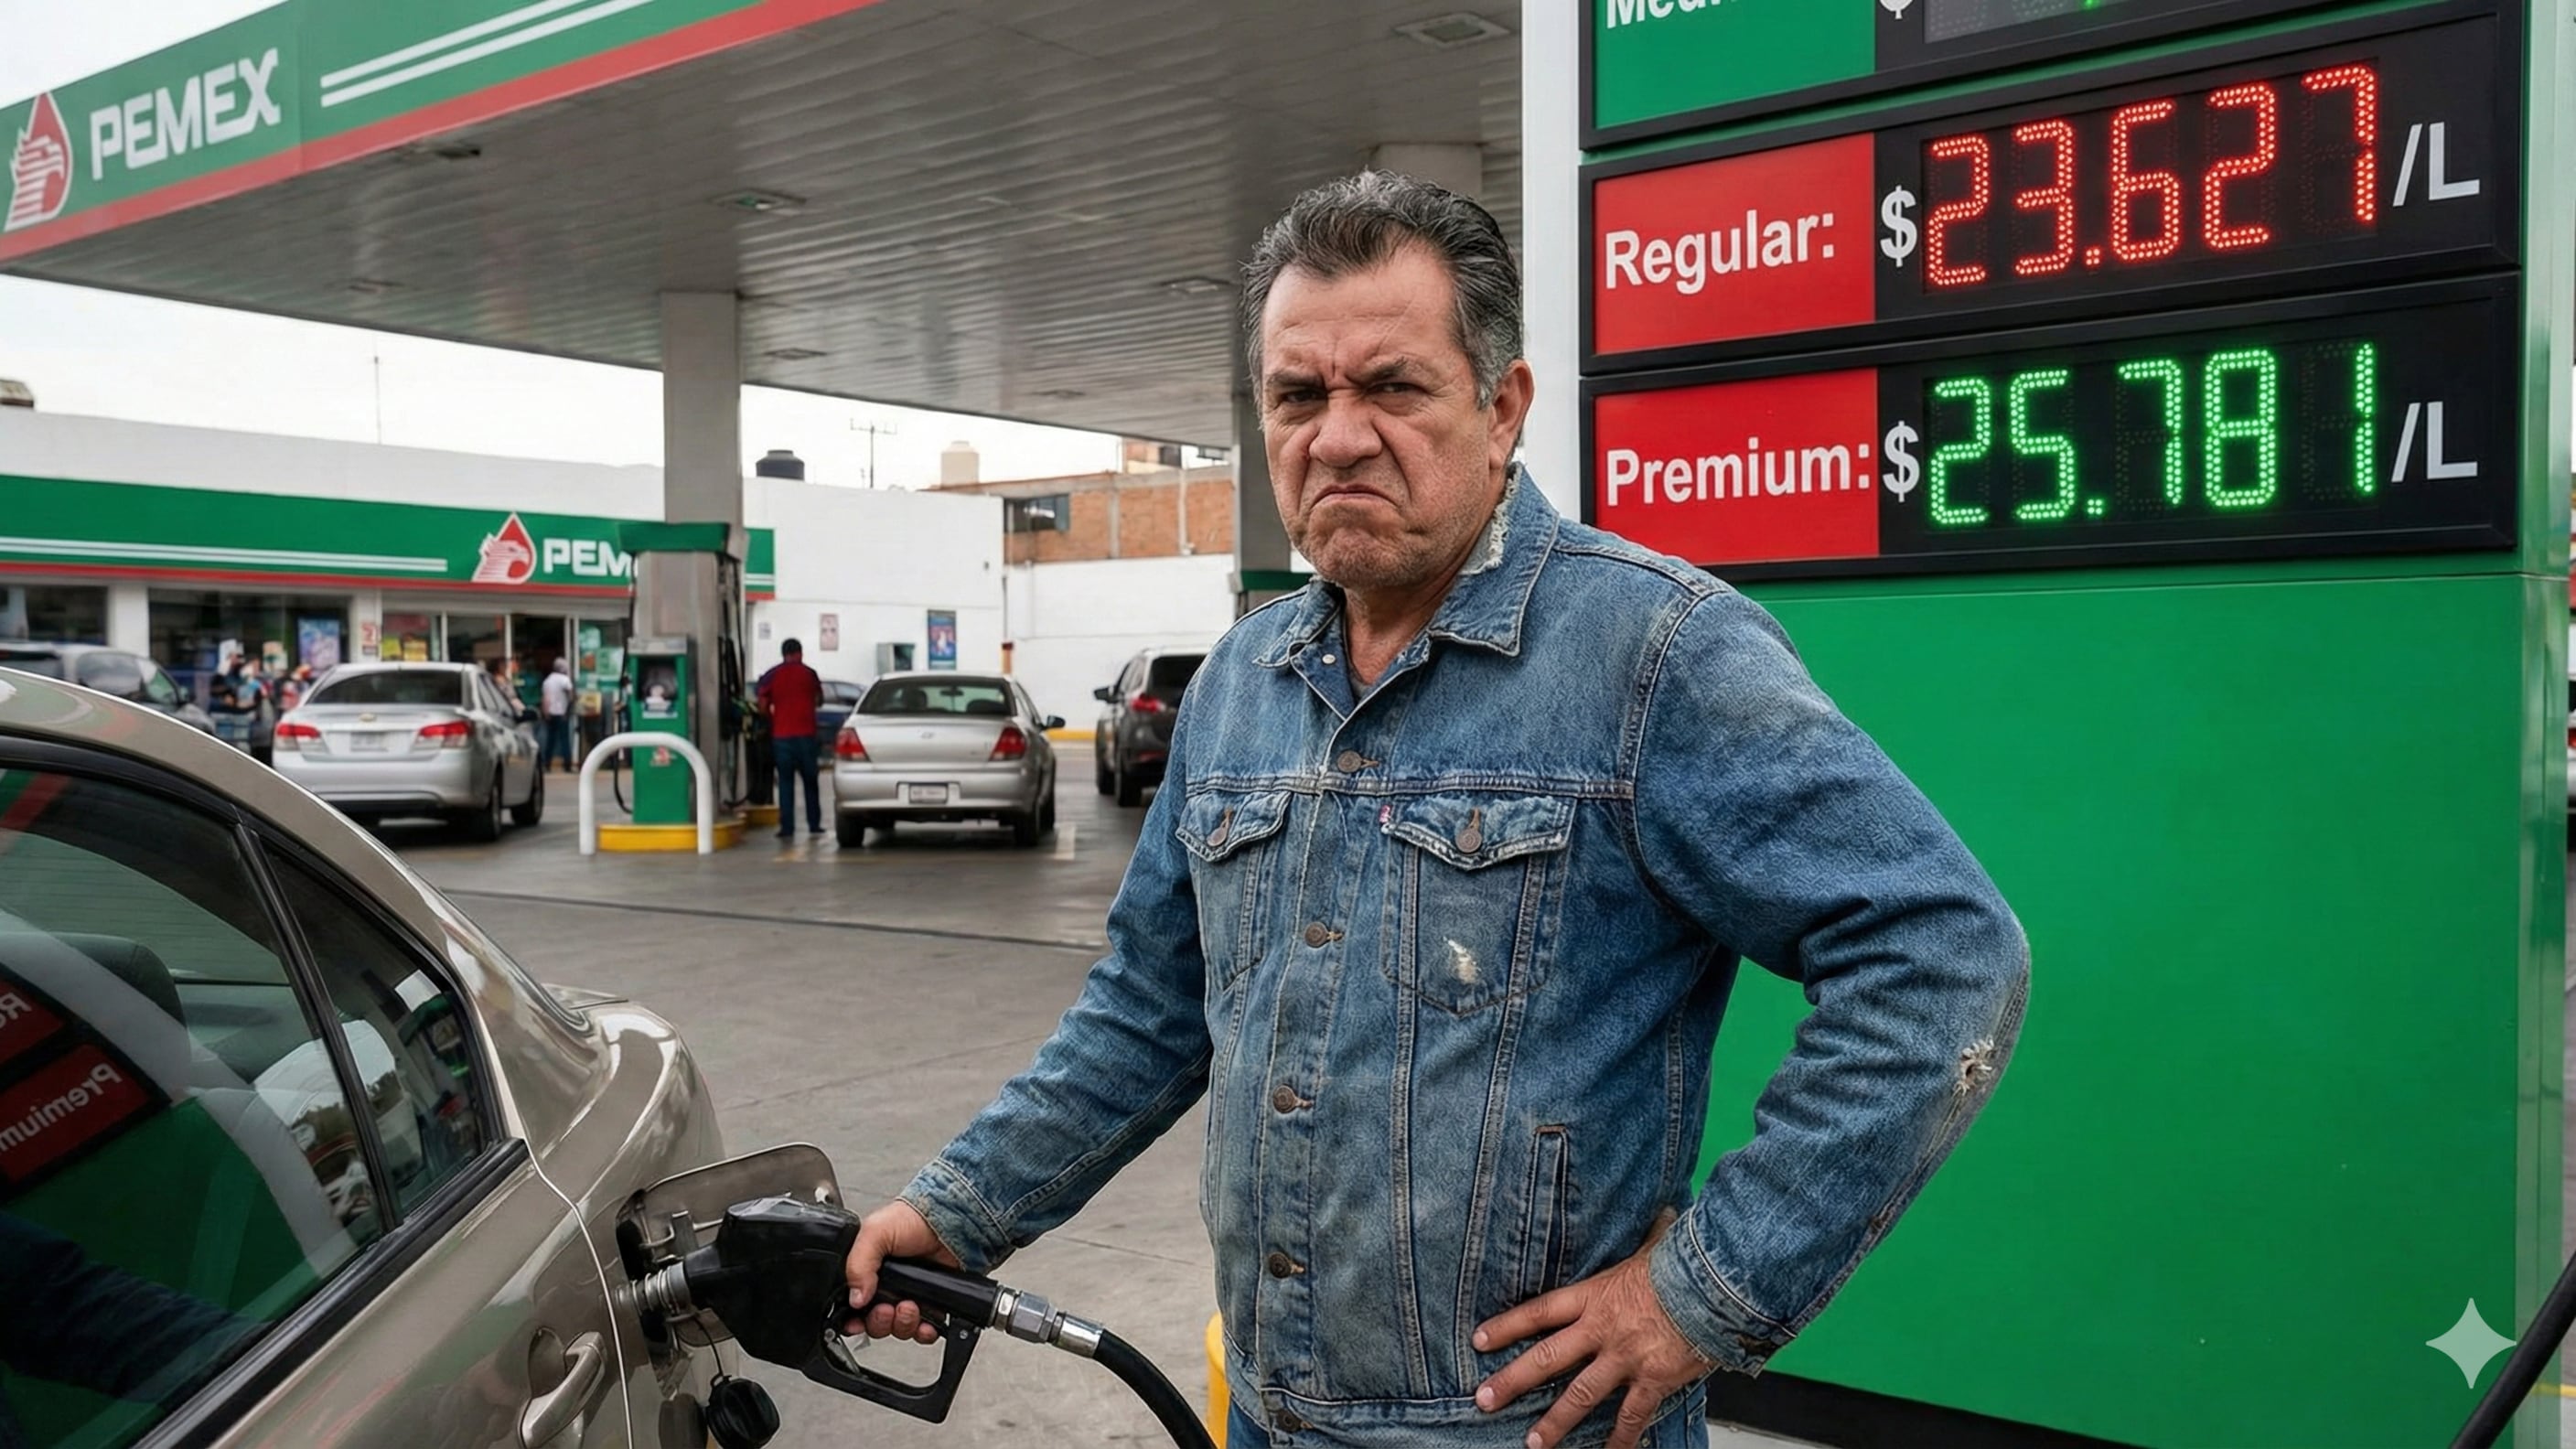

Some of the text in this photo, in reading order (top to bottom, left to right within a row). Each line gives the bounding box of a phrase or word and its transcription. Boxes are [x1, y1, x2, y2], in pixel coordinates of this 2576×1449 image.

[89, 47, 282, 181] PEMEX
[1605, 209, 1835, 295] Regular:
[1606, 436, 1871, 506] Premium:
[543, 538, 639, 577] PEM
